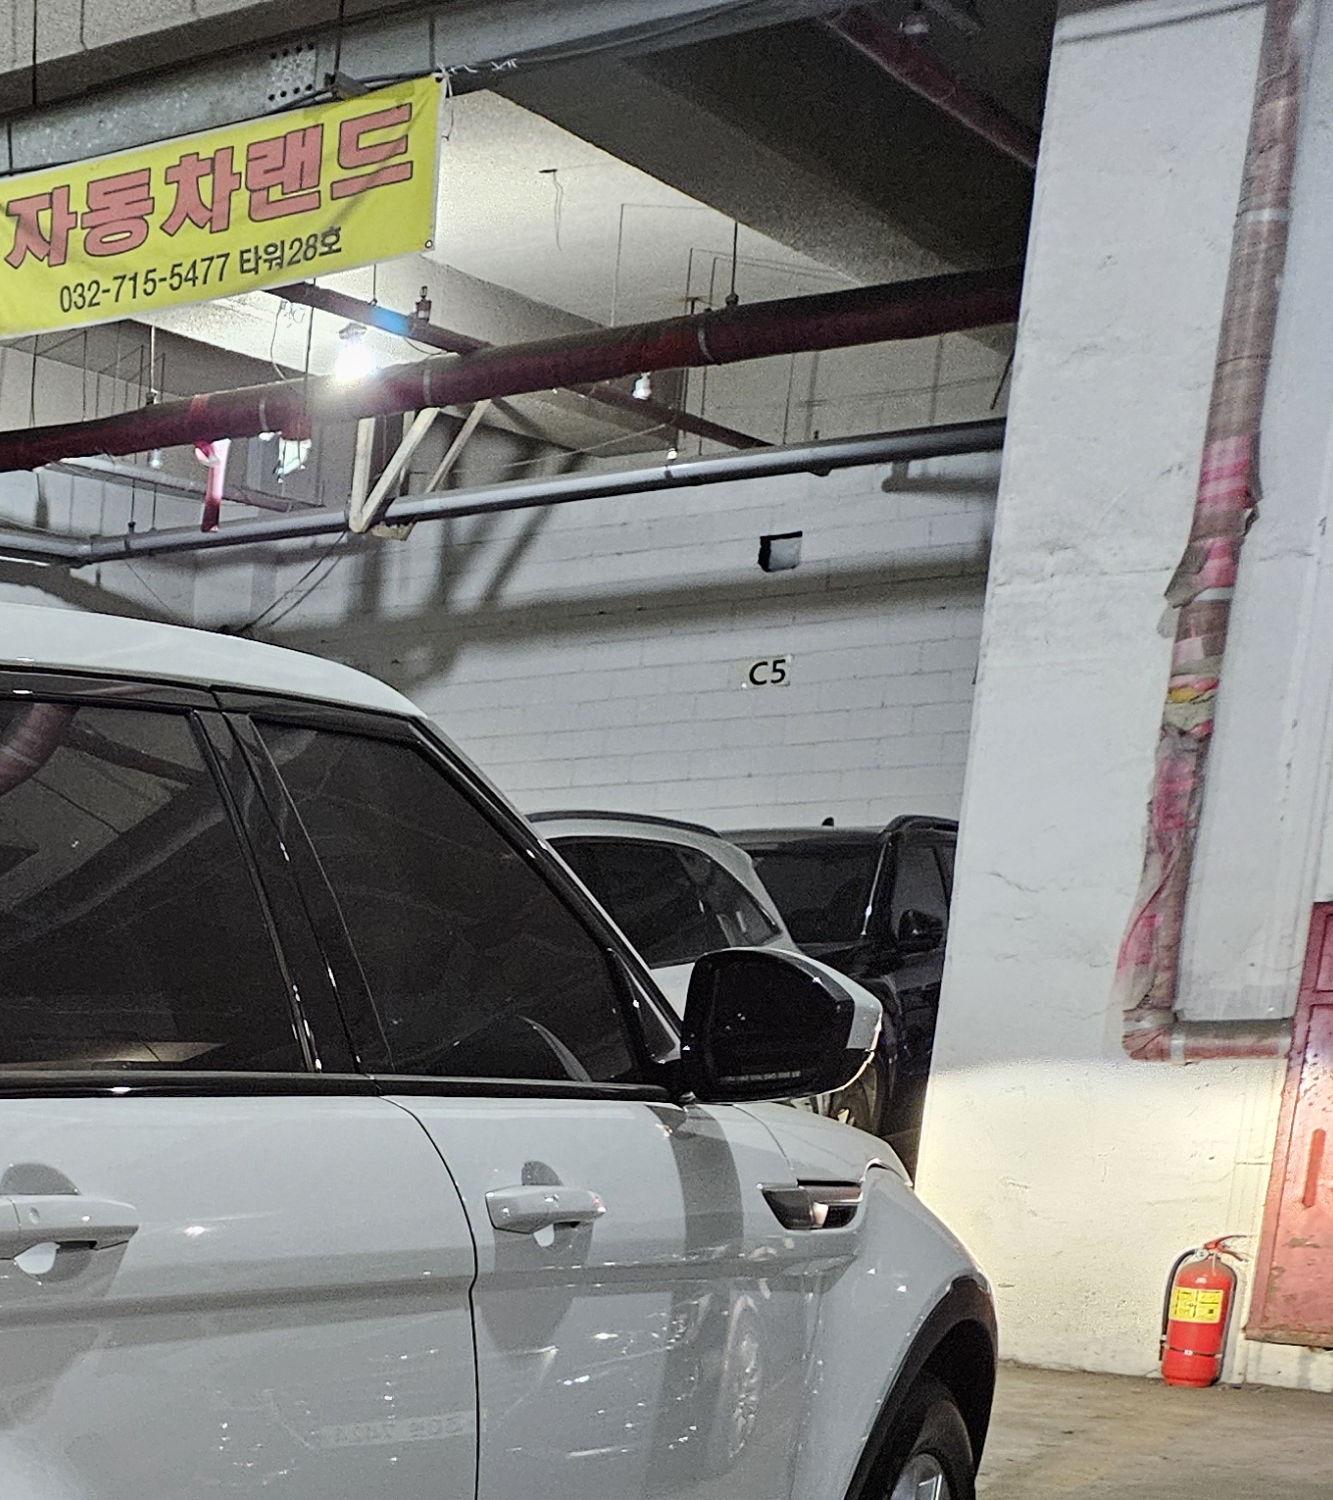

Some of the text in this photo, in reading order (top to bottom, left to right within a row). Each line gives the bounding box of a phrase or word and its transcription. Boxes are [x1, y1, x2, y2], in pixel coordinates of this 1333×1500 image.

[4, 102, 414, 269] 자동차랜드
[59, 225, 343, 313] 032-715-5477 타워28호
[749, 658, 786, 685] C5
